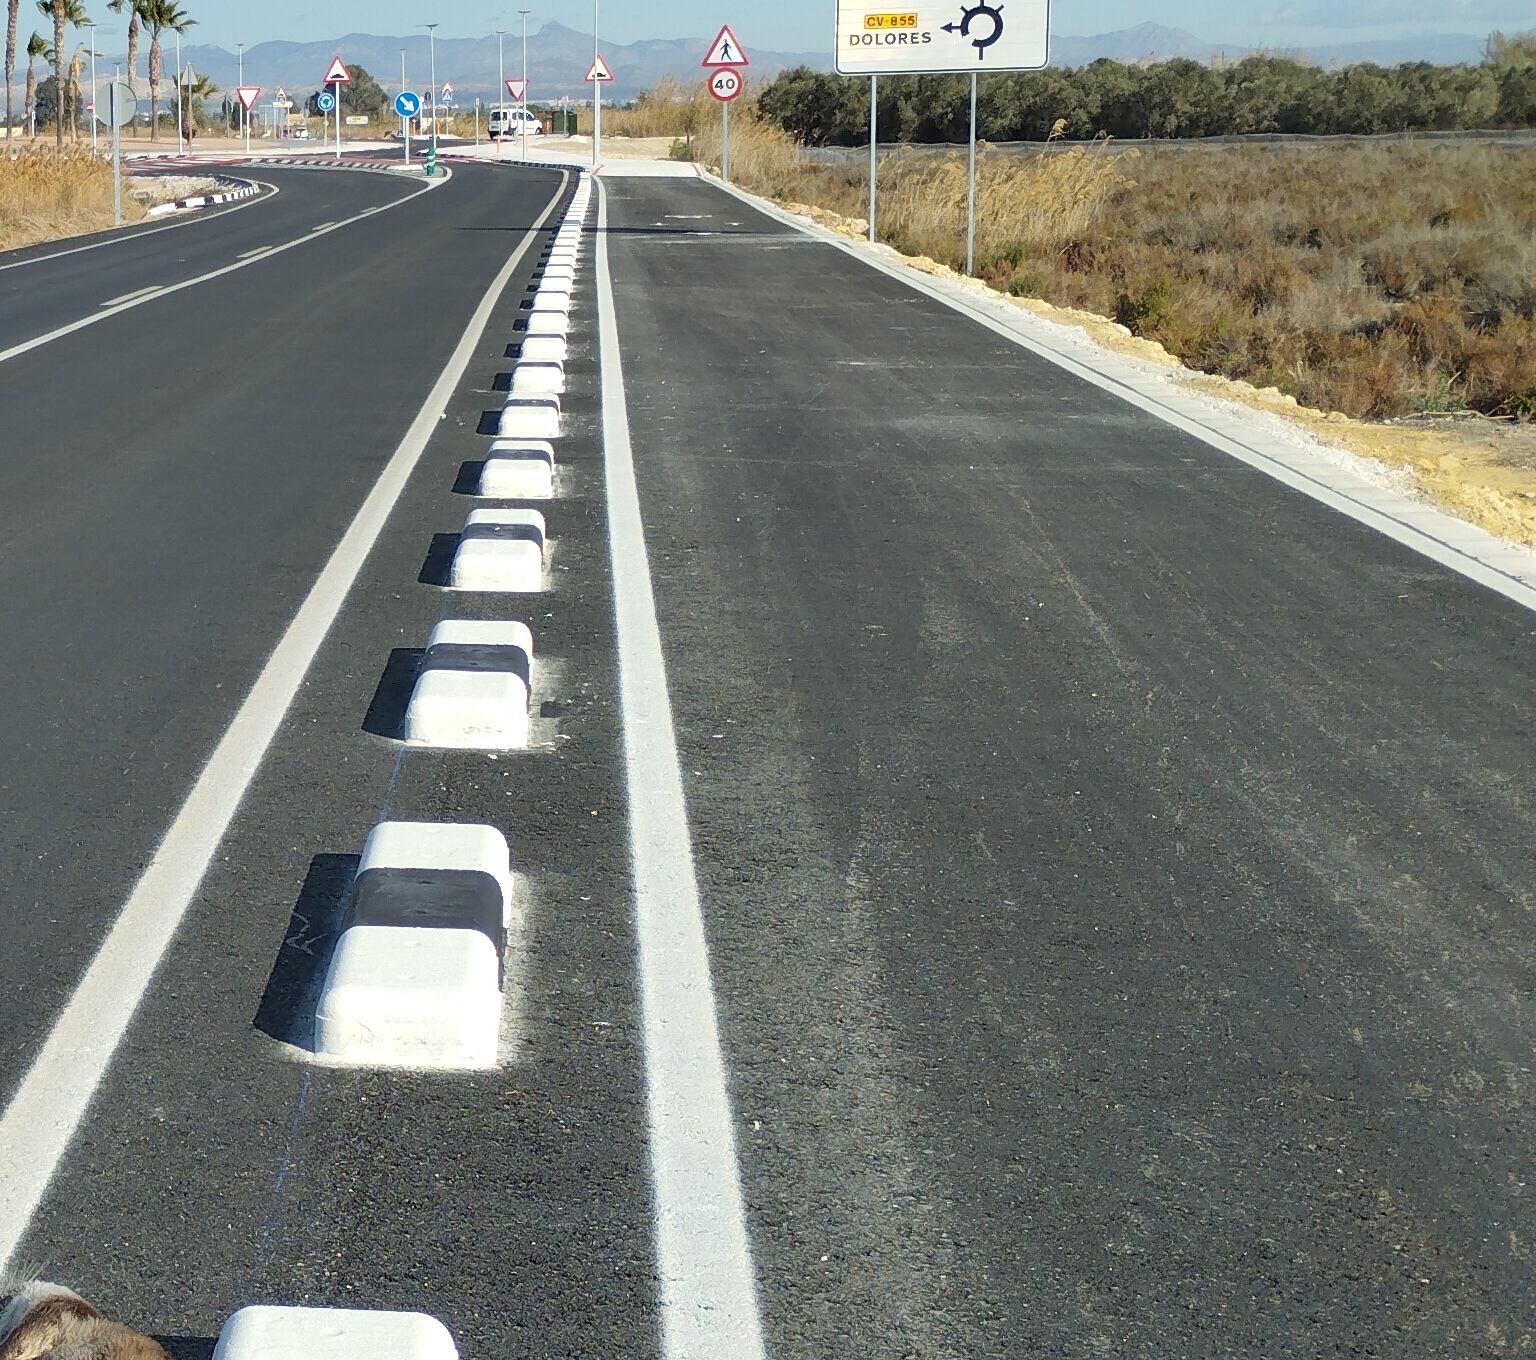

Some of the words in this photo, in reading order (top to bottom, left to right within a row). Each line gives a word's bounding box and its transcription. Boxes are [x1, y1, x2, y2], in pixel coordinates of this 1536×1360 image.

[866, 15, 916, 27] CV-855
[849, 31, 932, 46] DOLORES
[714, 78, 736, 90] 40
